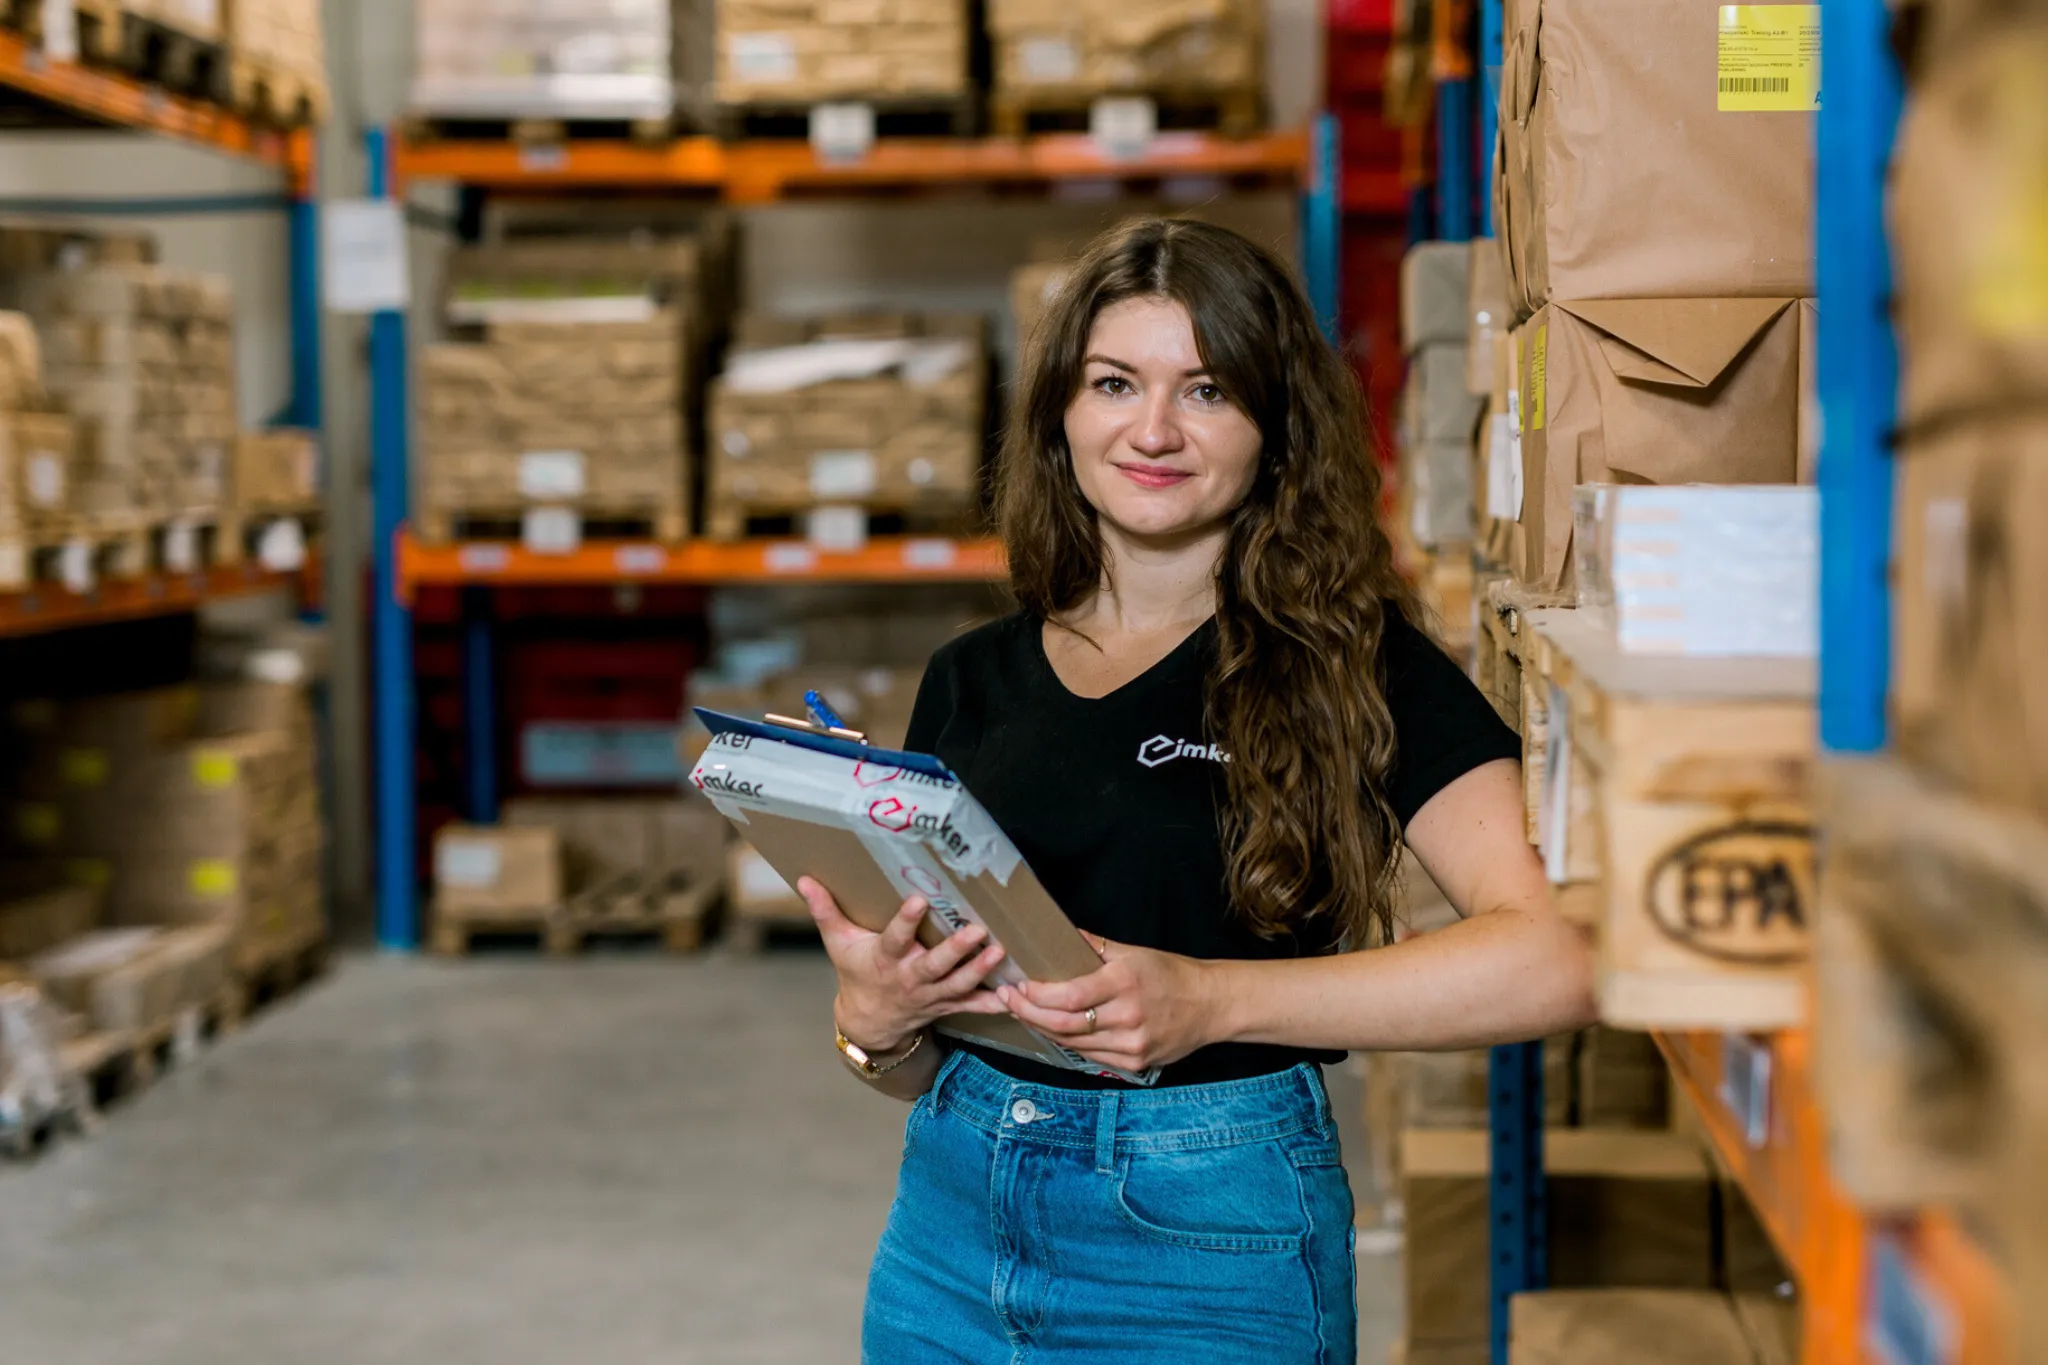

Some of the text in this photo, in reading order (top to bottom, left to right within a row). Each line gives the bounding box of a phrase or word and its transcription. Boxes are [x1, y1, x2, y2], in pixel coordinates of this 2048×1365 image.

[714, 731, 753, 750] ker
[694, 768, 763, 798] imker
[1683, 855, 1808, 932] EPA
